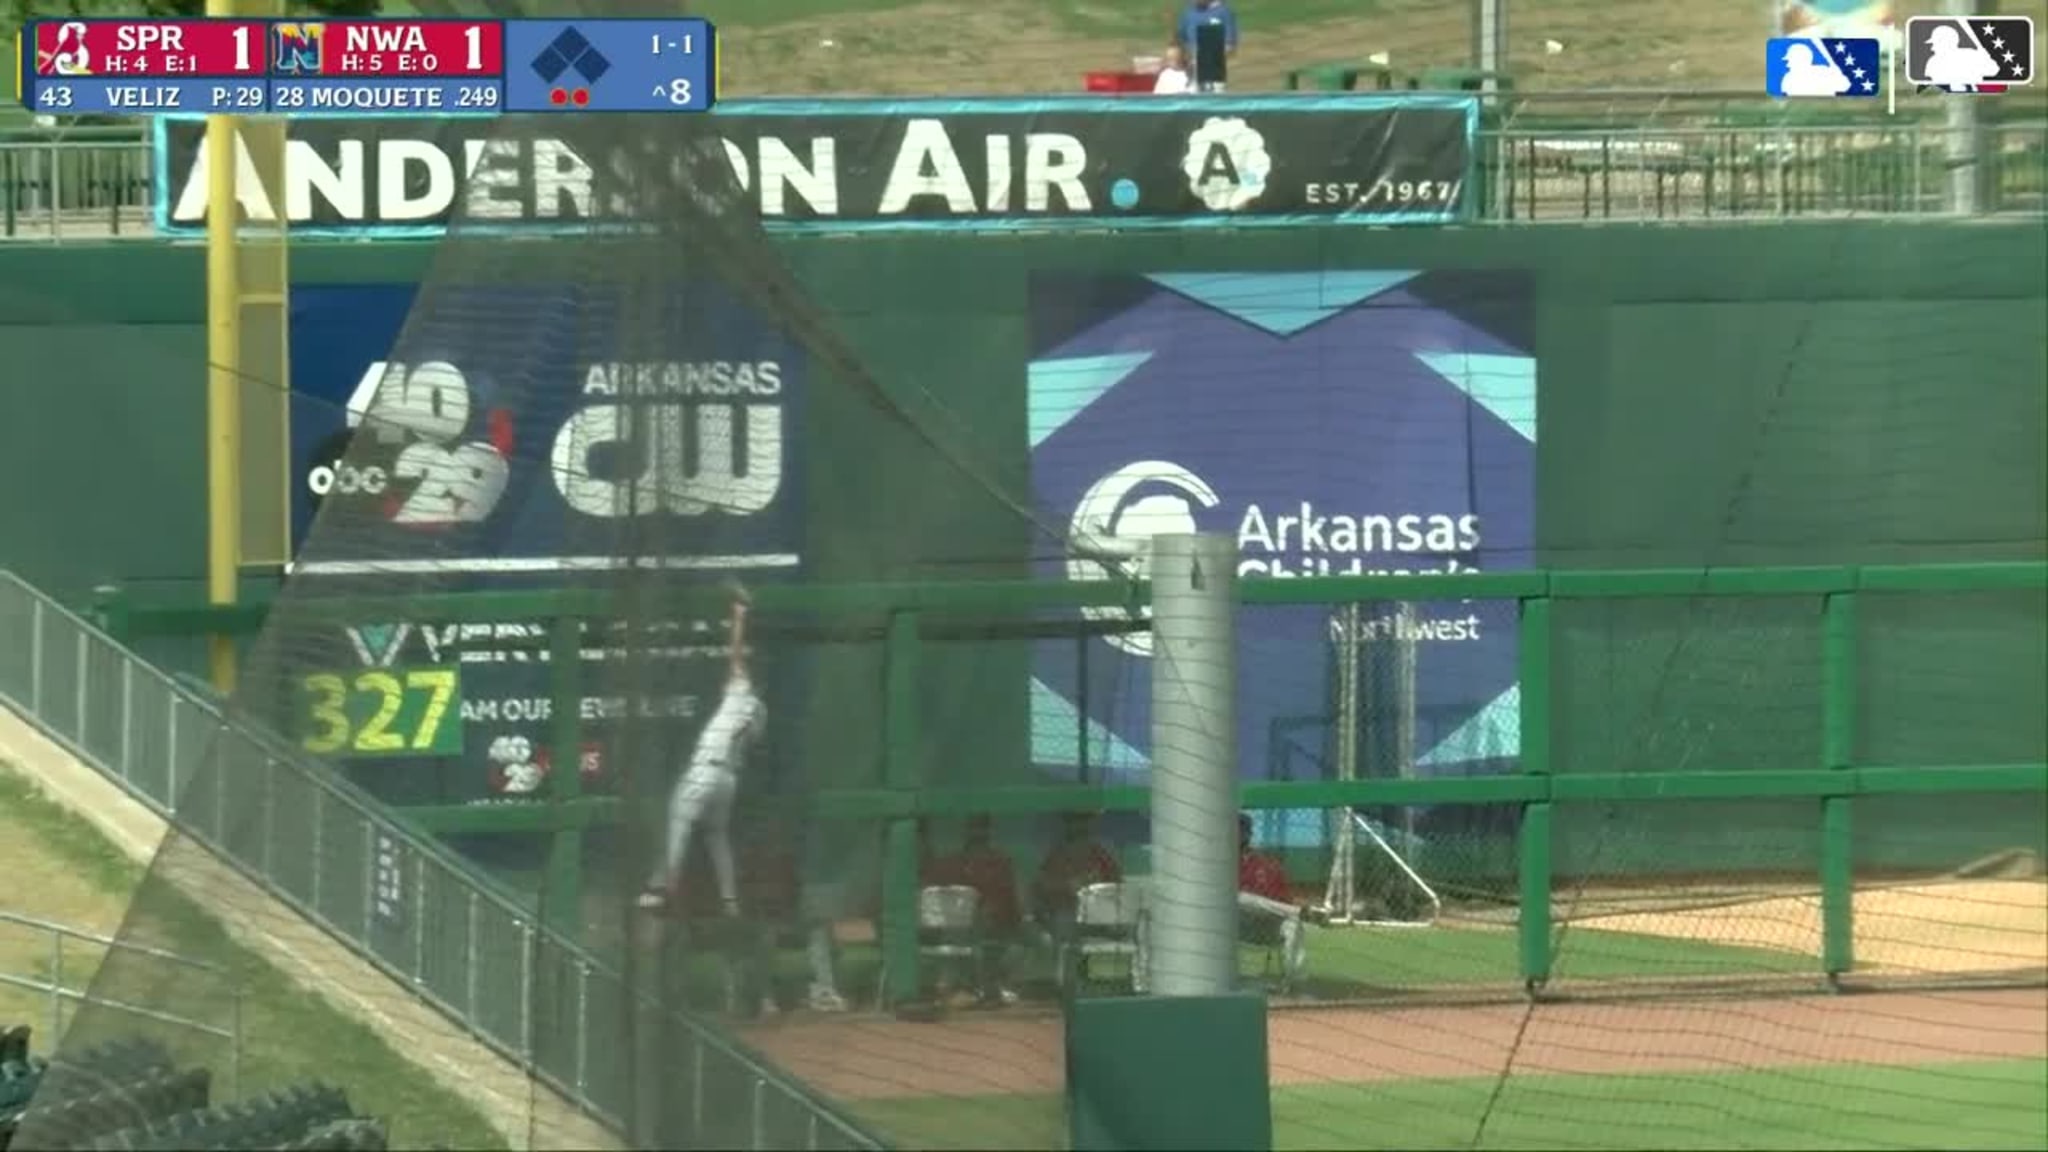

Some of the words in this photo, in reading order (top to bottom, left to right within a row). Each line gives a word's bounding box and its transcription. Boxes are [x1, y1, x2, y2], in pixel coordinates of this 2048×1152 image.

[173, 128, 840, 221] ANDERN
[1306, 182, 1368, 203] EST.
[583, 361, 782, 395] ARKANSAS
[1238, 501, 1481, 552] Arkansas
[304, 670, 456, 752] 327
